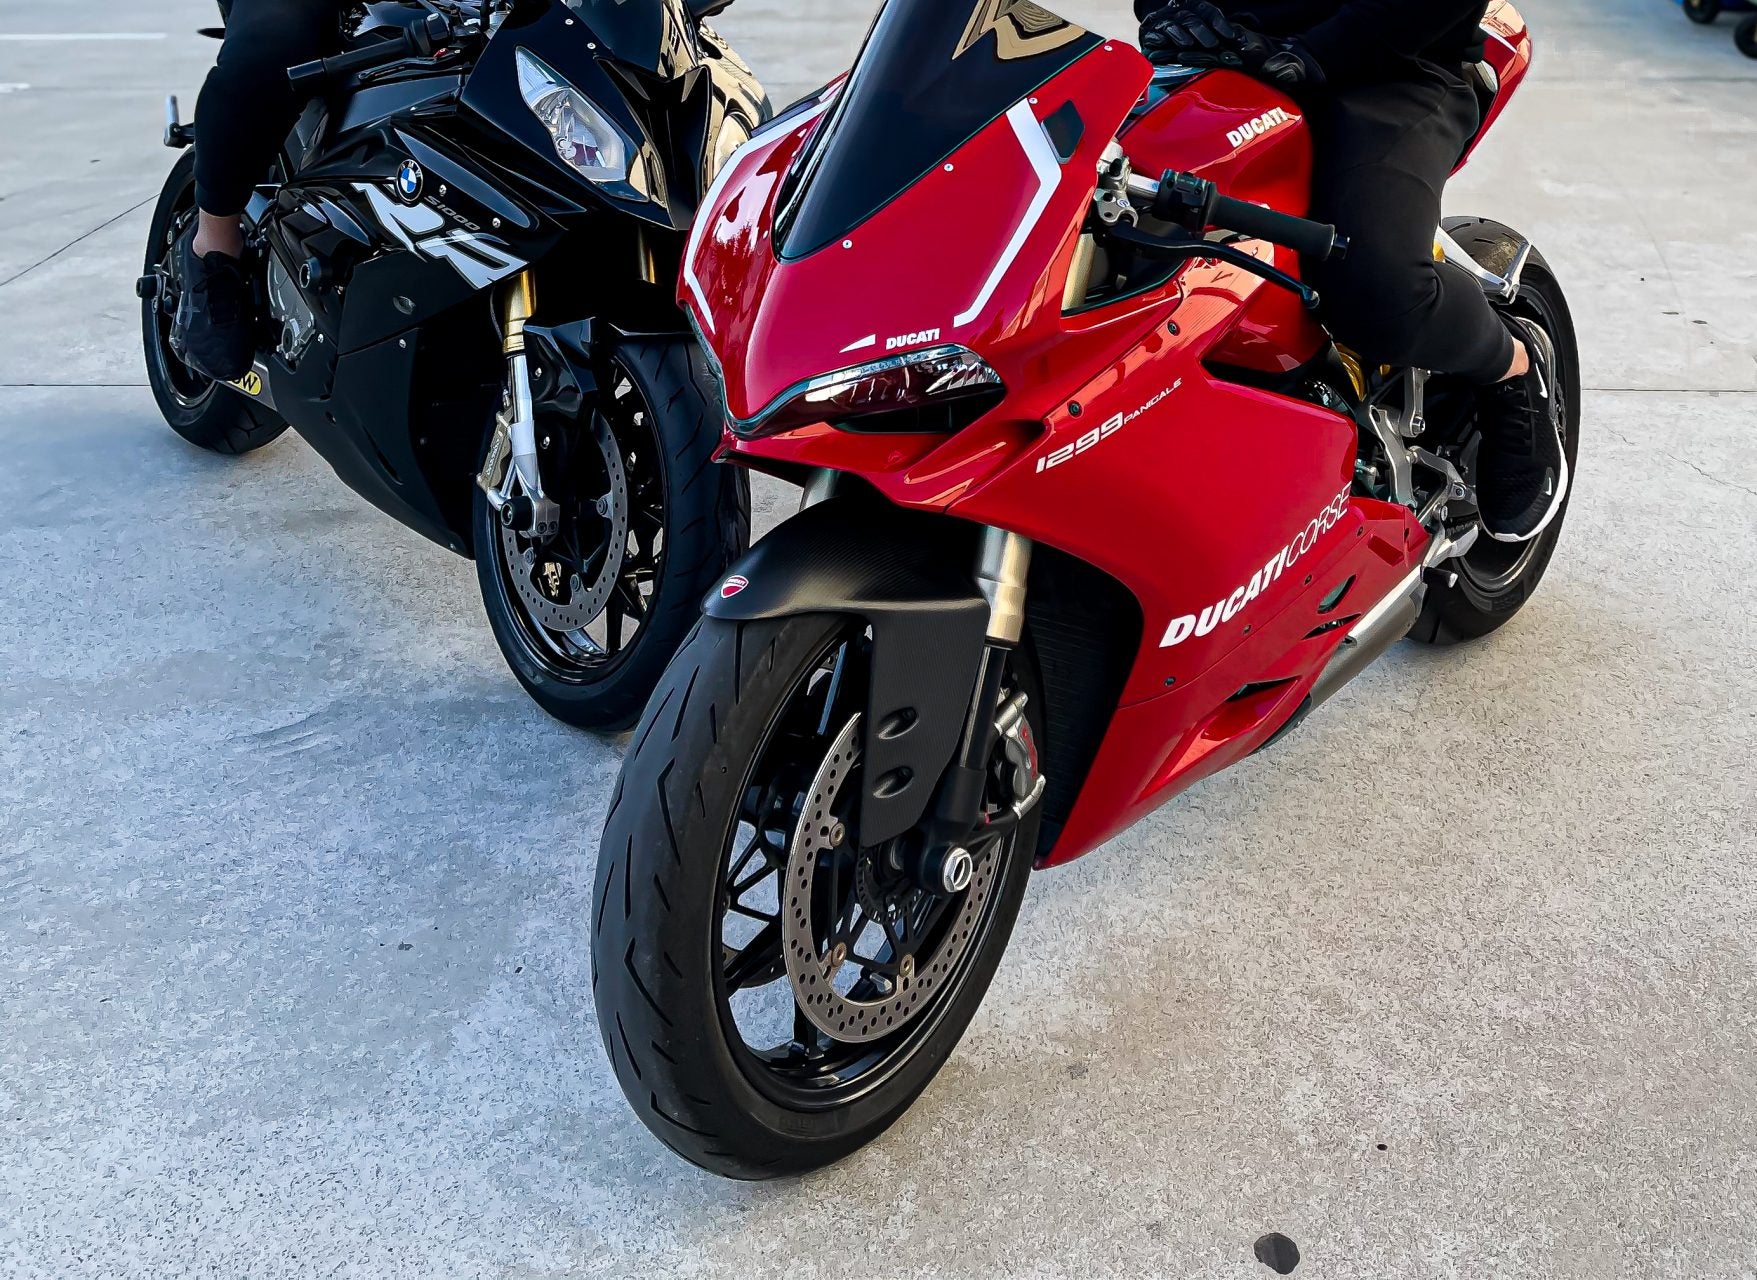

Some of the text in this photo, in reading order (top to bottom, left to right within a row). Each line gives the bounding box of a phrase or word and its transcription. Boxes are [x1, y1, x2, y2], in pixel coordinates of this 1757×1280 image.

[1225, 106, 1288, 148] DUCATI
[885, 327, 941, 350] DUCATI
[1035, 411, 1124, 474] 1299
[1158, 480, 1352, 648] DUCATI CORSE
